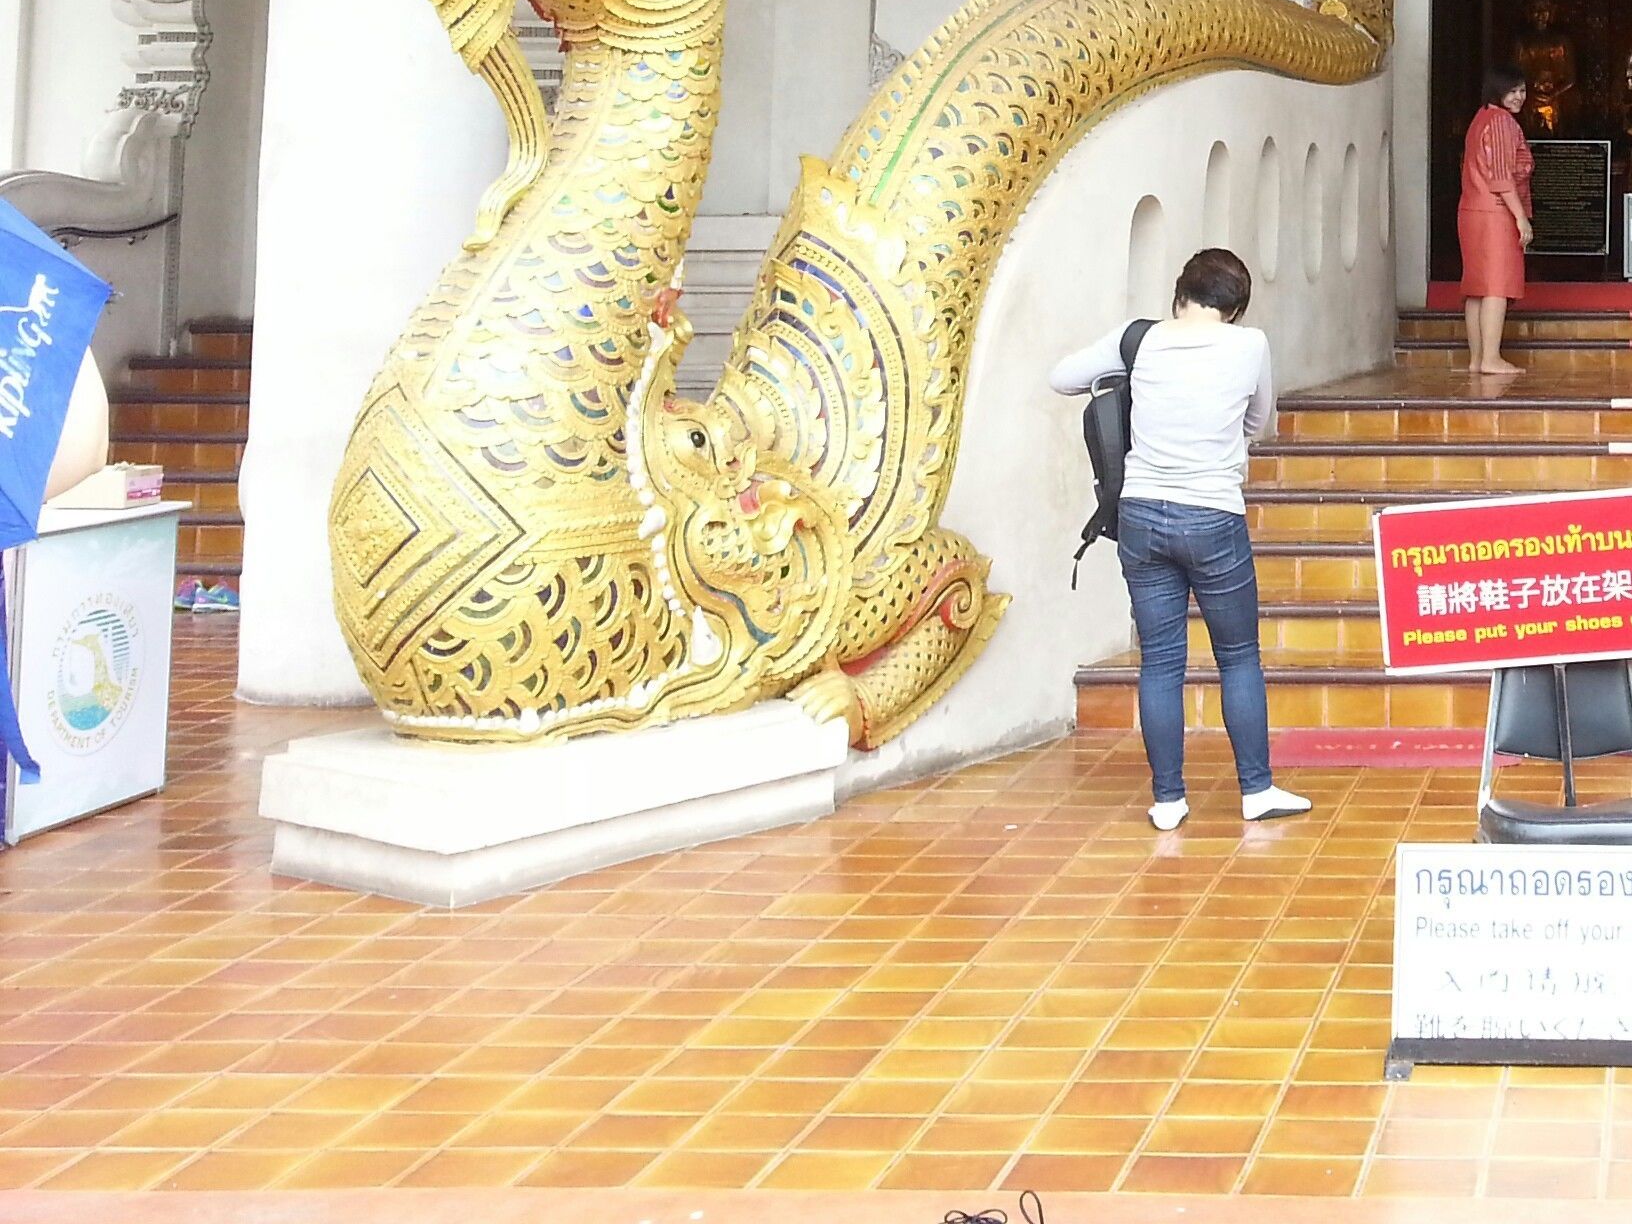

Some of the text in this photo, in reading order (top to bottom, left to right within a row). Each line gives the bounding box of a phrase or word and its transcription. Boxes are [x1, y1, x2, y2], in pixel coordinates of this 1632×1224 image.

[1403, 629, 1467, 646] Please
[1474, 623, 1508, 644] put
[1514, 620, 1558, 640] your
[1565, 615, 1623, 632] shoes
[1416, 916, 1480, 937] Please
[1492, 918, 1534, 940] take
[1544, 918, 1570, 940] off
[1580, 923, 1621, 945] your
